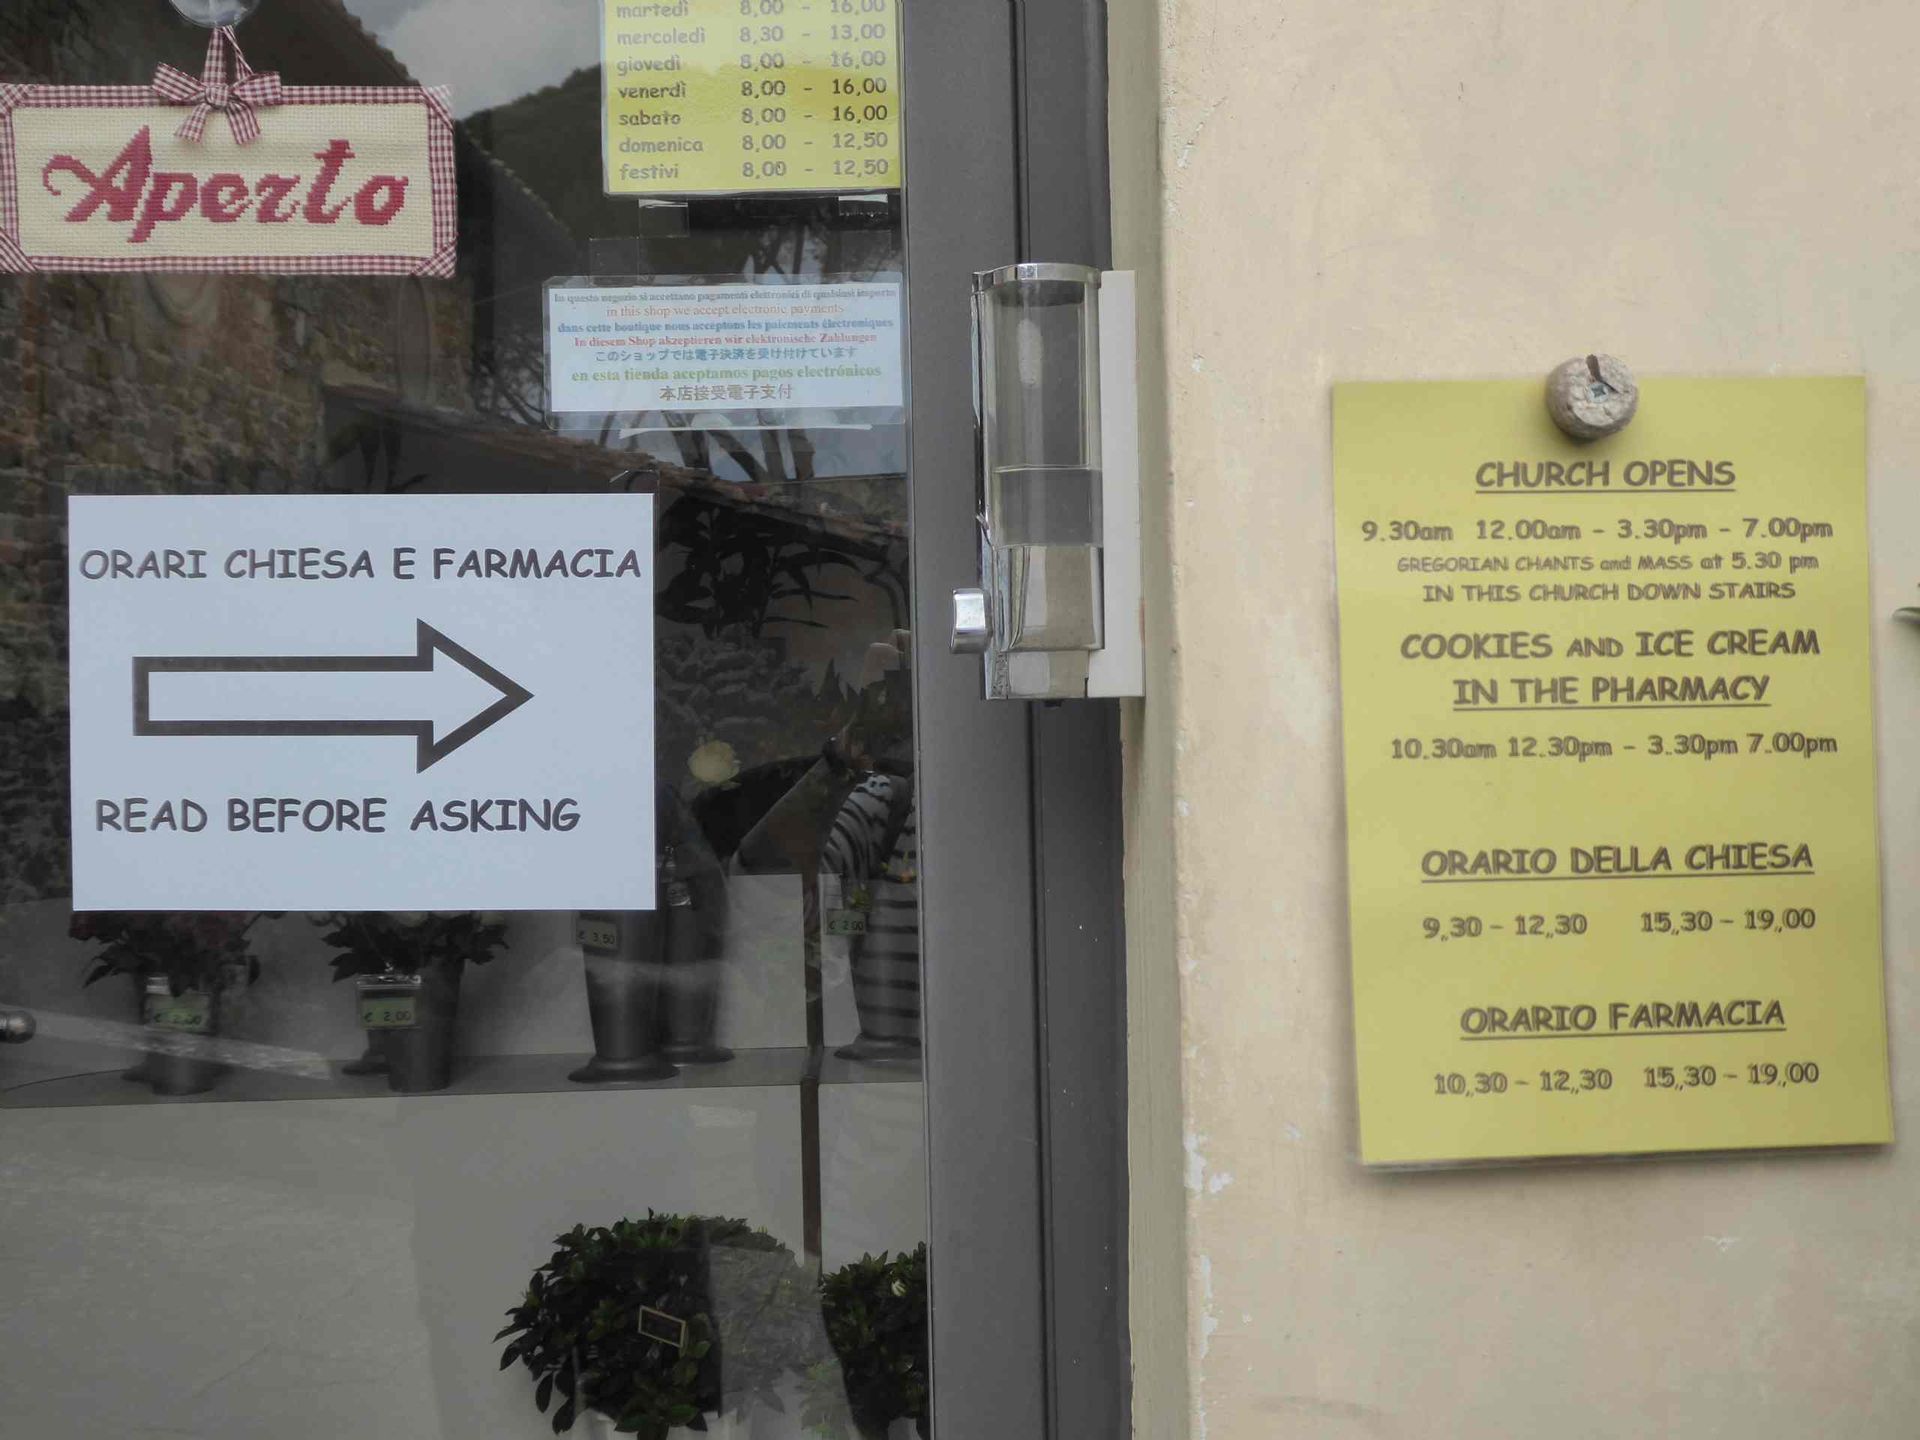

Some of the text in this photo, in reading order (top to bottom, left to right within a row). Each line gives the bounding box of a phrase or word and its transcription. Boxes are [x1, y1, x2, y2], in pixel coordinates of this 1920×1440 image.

[617, 0, 689, 18] martedì
[740, 0, 784, 18] 8,00
[831, 0, 886, 15] 16,00
[617, 26, 706, 46] mercoledì
[740, 26, 784, 46] 8,30
[831, 23, 886, 43] 13,00
[617, 53, 681, 77] giovedì
[741, 53, 785, 73] 8,00
[831, 51, 887, 71] 16,00
[618, 80, 687, 99] venerdì
[741, 80, 786, 99] 8,00
[832, 78, 887, 97] 16,00
[618, 109, 682, 127] sabato
[742, 108, 786, 127] 8,00
[833, 105, 888, 124] 16,00
[619, 136, 705, 154] domenica
[742, 134, 787, 154] 8,00
[833, 132, 888, 152] 12,50
[619, 163, 680, 181] festivi
[743, 161, 787, 181] 8,00
[834, 159, 889, 179] 12,50
[42, 125, 410, 244] Aperto
[607, 302, 845, 319] in this shop we accept electronic payments
[558, 317, 895, 333] dans cette boutique nous acceptons les paiements électroniques
[574, 332, 878, 349] In diesem Shop akzeptieren wir elektronische Zahlungen
[571, 363, 882, 382] en esta tienda aceptamos pagos electrónicos
[659, 383, 793, 401] 本店接受電子支付
[1475, 458, 1736, 488] CHURCH OPENS
[1361, 519, 1454, 542] 9.30am
[1475, 518, 1582, 541] 12.00am
[1617, 518, 1708, 545] 3.30pm
[1742, 516, 1834, 543] 7.00pm
[79, 546, 642, 581] ORARI CHIESA E FARMACIA
[1397, 551, 1820, 575] GREGORIAN CHANTS and MASS at 5.30 pm
[1422, 581, 1797, 603] IN THIS CHURCH DOWN STAIRS
[1400, 628, 1821, 660] COOKIES AND ICE CREAM
[1453, 675, 1771, 705] IN THE PHARMACY
[1391, 737, 1498, 761] 10.30am
[1508, 735, 1613, 763] 12.30pm
[1647, 733, 1739, 761] 3.30pm
[1747, 732, 1839, 760] 7.00pm
[96, 796, 582, 834] READ BEFORE ASKING
[1421, 842, 1814, 877] ORARIO DELLA CHIESA
[1422, 914, 1483, 942] 9,30
[1514, 912, 1588, 940] 12,30
[1641, 910, 1713, 936] 15,30
[1744, 907, 1817, 934] 19,00
[384, 1010, 412, 1024] 2,00
[1460, 1000, 1786, 1034] ORARIO FARMACIA
[1433, 1071, 1508, 1098] 10,30
[1539, 1068, 1613, 1096] 12,30
[1643, 1065, 1717, 1092] 15,30
[1747, 1061, 1820, 1088] 19,00
